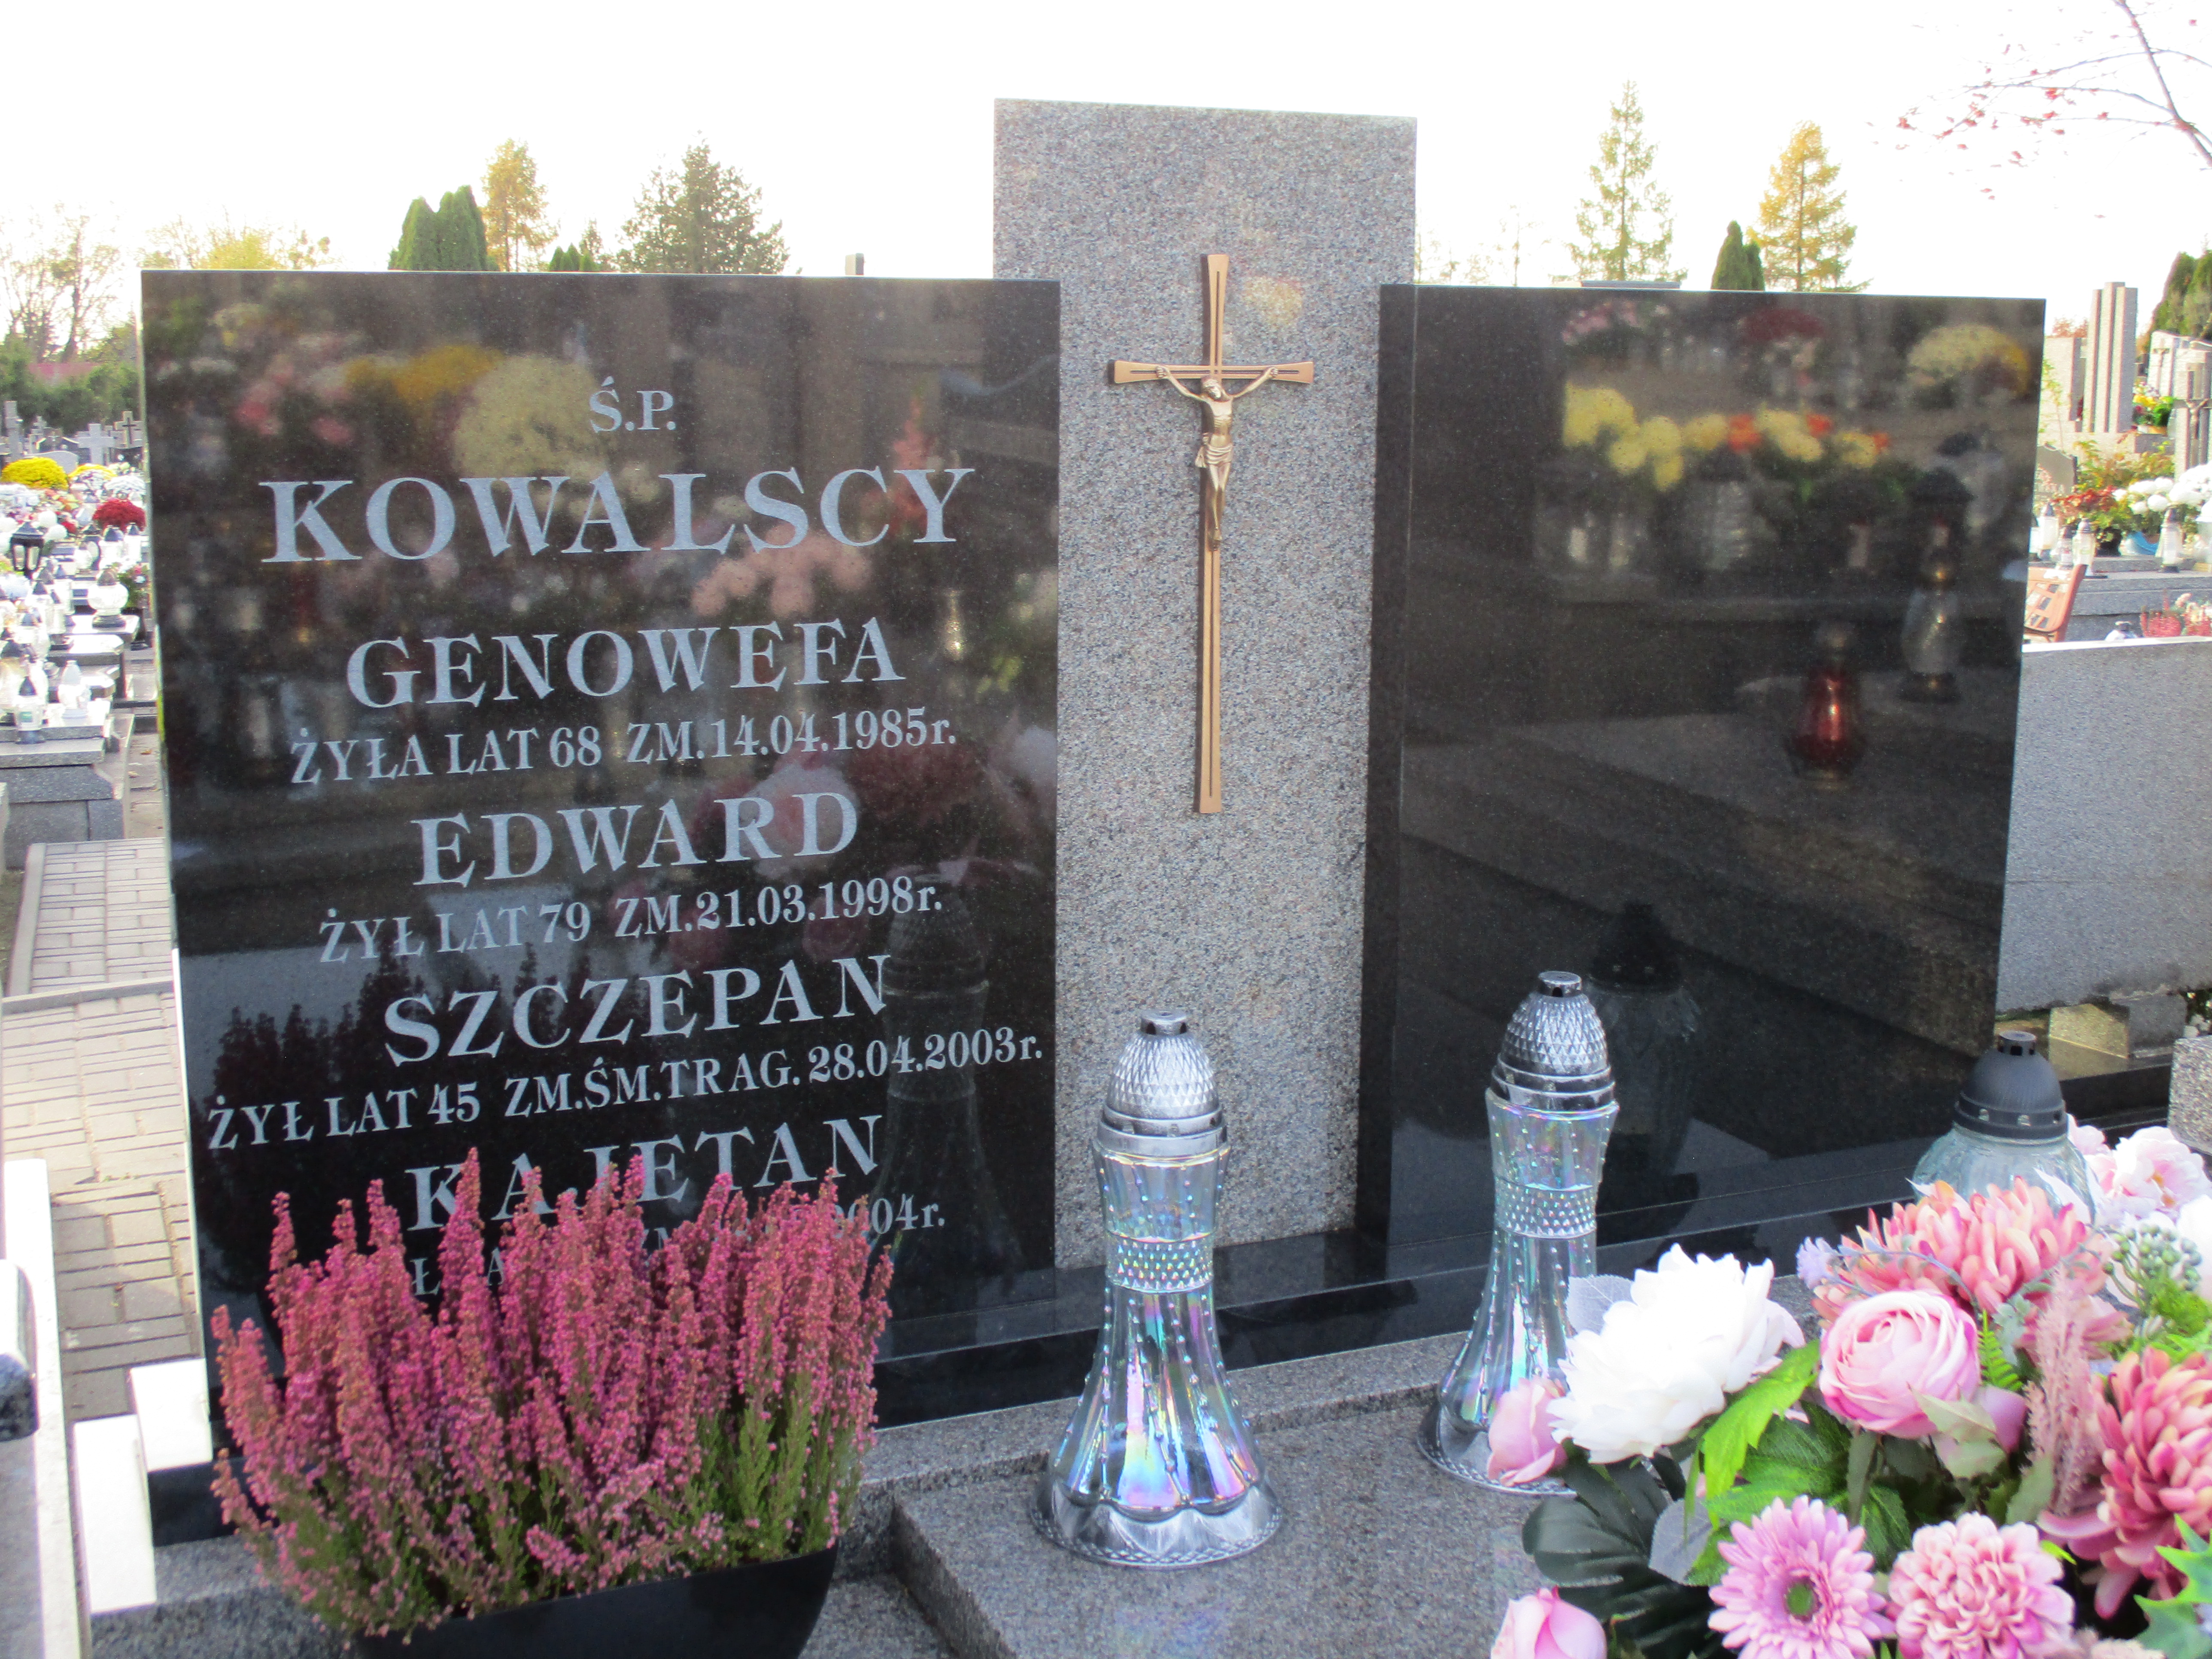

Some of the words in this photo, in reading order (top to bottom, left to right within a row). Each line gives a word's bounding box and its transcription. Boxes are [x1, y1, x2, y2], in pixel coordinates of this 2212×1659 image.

[589, 375, 676, 433] Ś.P.
[258, 465, 975, 563] KOWALSCY
[346, 617, 907, 708] GENOWEFA
[291, 727, 434, 787] ŻYŁA
[445, 729, 539, 775] LAT
[549, 725, 603, 768] 68
[410, 792, 858, 889] EDWARD
[319, 908, 425, 963] ŻYŁ
[435, 905, 528, 954] LAT
[539, 901, 592, 944] 79
[385, 954, 891, 1067] SZCZEPAN
[208, 1095, 315, 1150] ŻYŁ
[323, 1087, 419, 1137] LAT
[427, 1082, 481, 1125] 45
